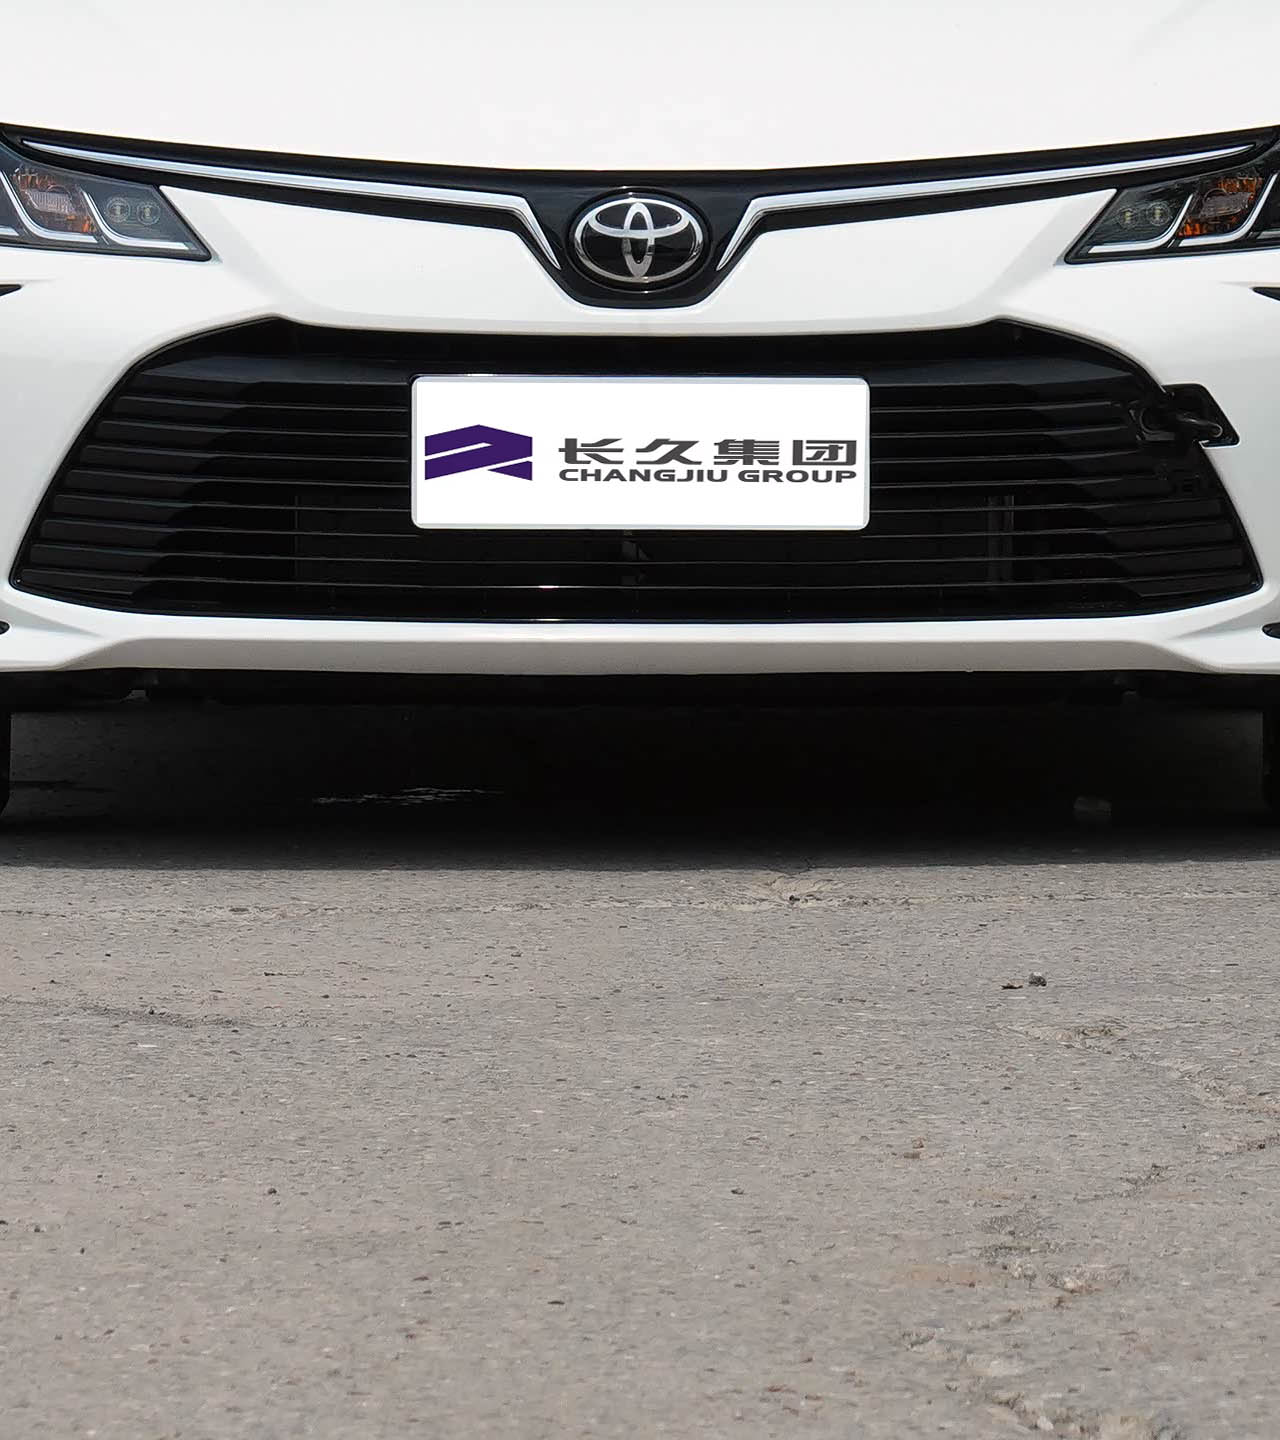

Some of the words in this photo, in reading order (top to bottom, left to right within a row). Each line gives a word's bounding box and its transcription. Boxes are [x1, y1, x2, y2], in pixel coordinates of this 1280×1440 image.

[558, 437, 857, 465] 长久集团
[558, 468, 729, 483] CHANGJIU
[738, 469, 858, 483] GROUP
